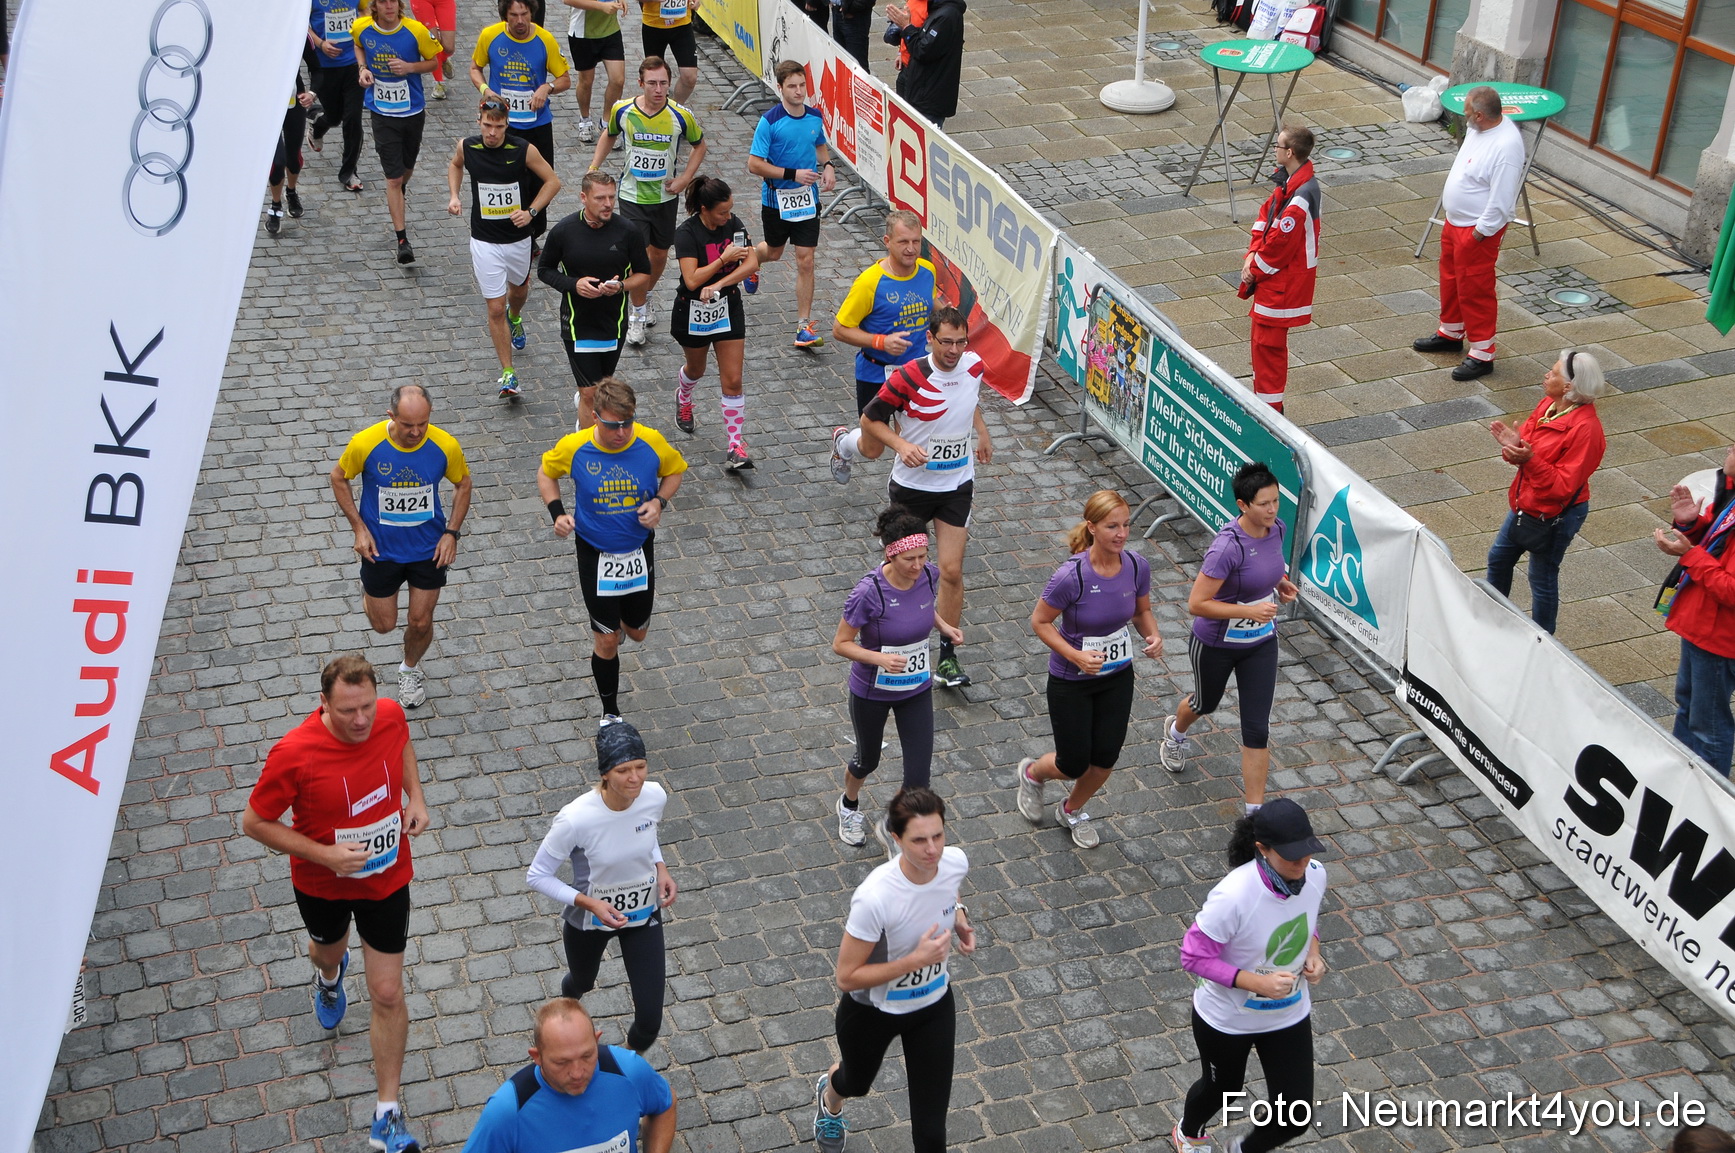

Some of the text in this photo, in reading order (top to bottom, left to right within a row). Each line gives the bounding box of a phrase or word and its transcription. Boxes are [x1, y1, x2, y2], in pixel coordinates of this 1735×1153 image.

[329, 17, 354, 32] 3413
[377, 88, 406, 101] 3412
[634, 133, 672, 142] BOCK
[634, 156, 665, 169] 2879
[488, 193, 512, 206] 218
[782, 193, 811, 209] 2829
[694, 306, 725, 323] 3392
[1152, 390, 1182, 429] Mehr
[1174, 369, 1243, 436] Event-Leit-Systeme
[932, 441, 967, 460] 2631
[1150, 416, 1225, 498] für Ihr Event!
[936, 462, 961, 470] Manfred
[1147, 451, 1163, 474] Miet
[1164, 468, 1171, 480] &
[1171, 474, 1196, 504] Service
[1196, 496, 1214, 521] Line:
[384, 495, 429, 512] 3424
[50, 320, 165, 796] Audi BKK
[604, 558, 643, 578] 2248
[614, 581, 633, 590] Armin
[1303, 582, 1379, 646] Gebäude Service GmbH
[885, 676, 923, 685] Bernadette
[1454, 727, 1468, 748] die
[1469, 743, 1519, 798] verbinden
[337, 822, 391, 840] PARTL Neumarkt
[359, 828, 396, 854] 796
[1563, 744, 1735, 951] SW
[363, 856, 388, 870] ichael
[618, 881, 648, 892] Neumarkt
[1551, 817, 1701, 964] stadtwerke
[909, 987, 930, 998] Anke
